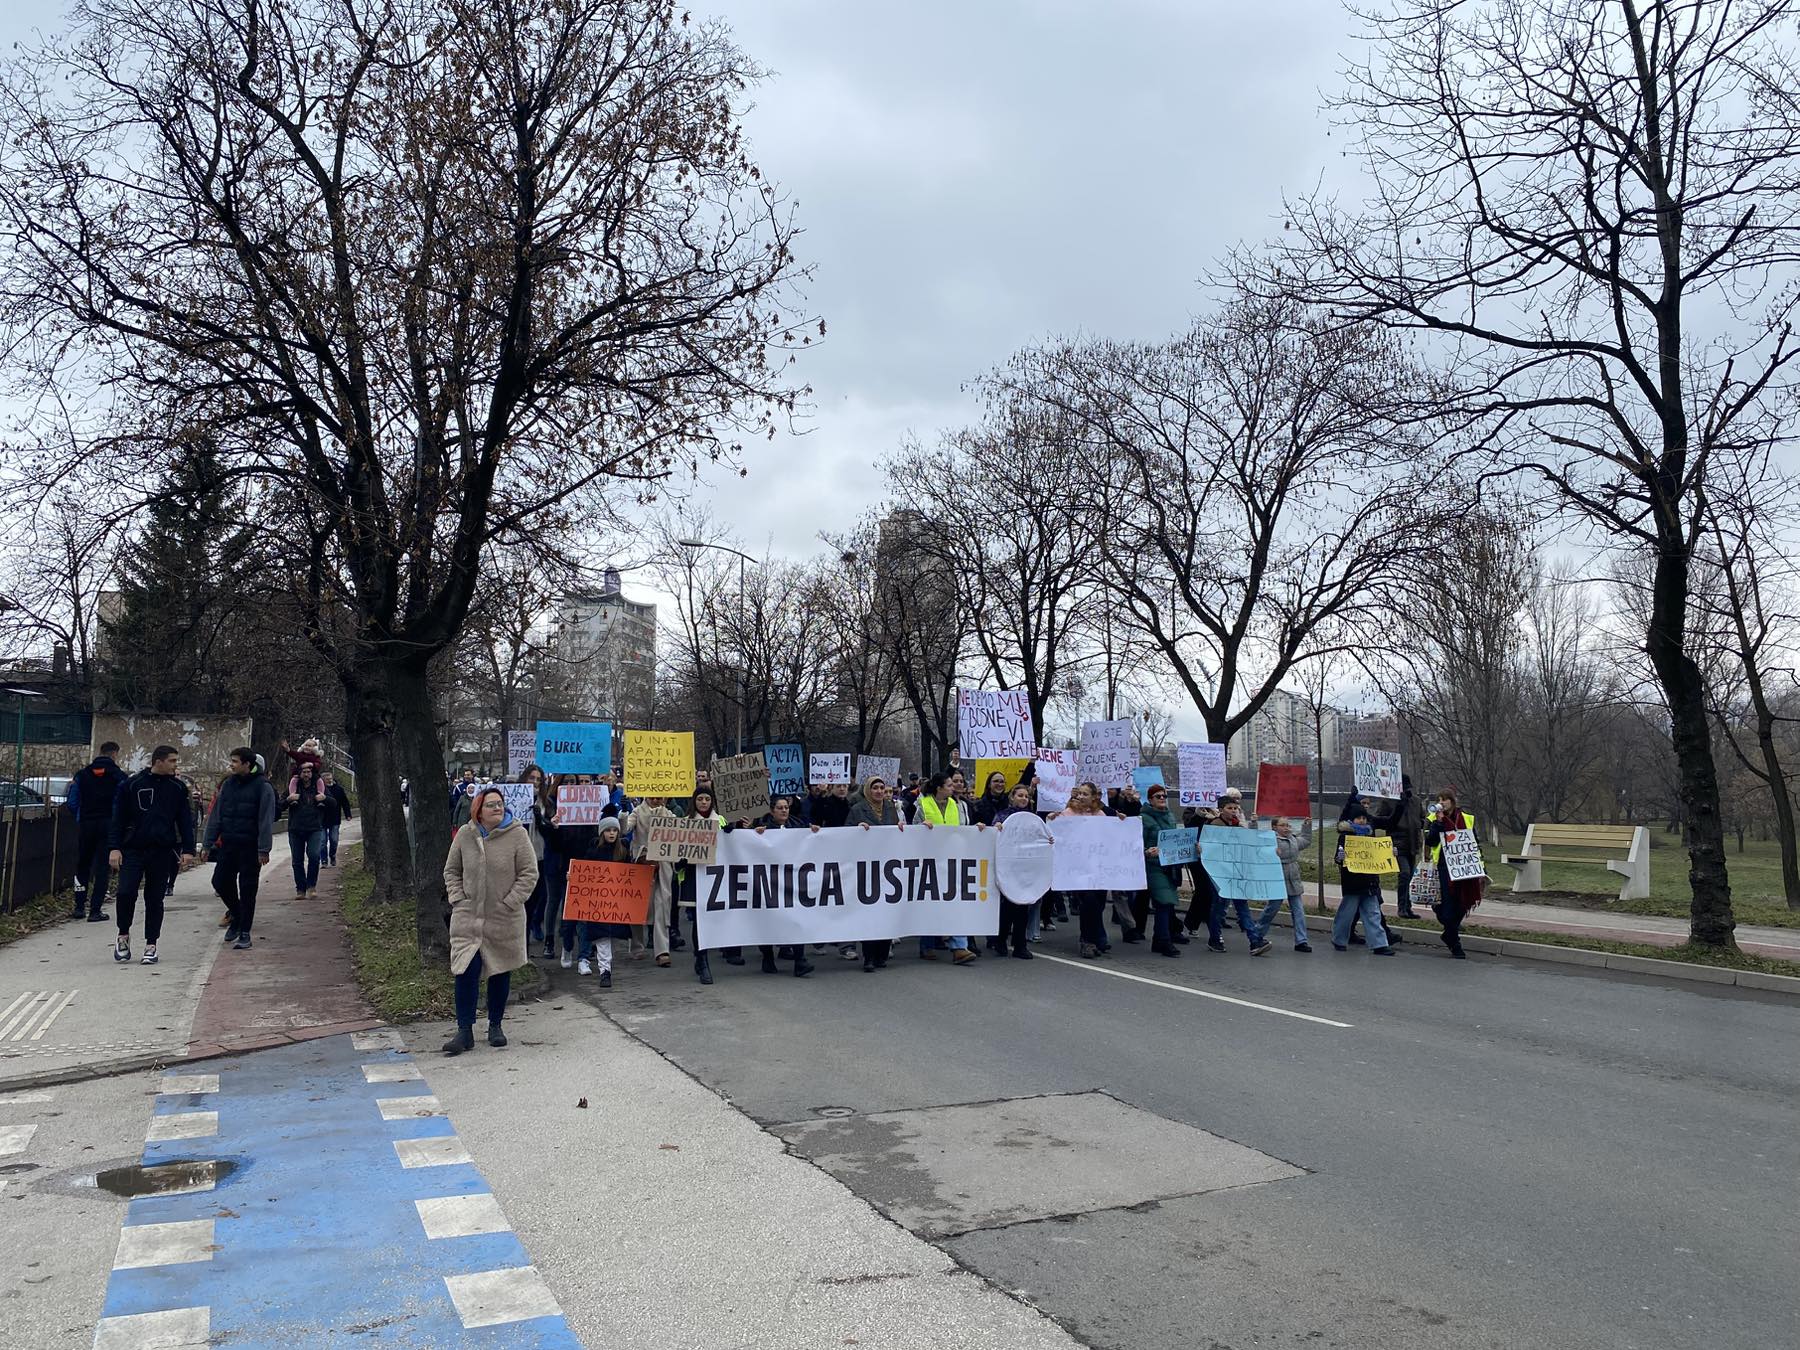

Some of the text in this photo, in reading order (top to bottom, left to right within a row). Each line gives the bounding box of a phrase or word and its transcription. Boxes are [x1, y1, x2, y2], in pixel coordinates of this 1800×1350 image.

[969, 706, 1007, 728] BOSNE
[1006, 719, 1025, 741] VI
[1104, 727, 1122, 738] STE
[634, 735, 677, 745] U INAT
[959, 729, 987, 758] NAS
[543, 739, 584, 754] BUREK
[627, 746, 681, 757] APATIJI
[769, 748, 800, 763] ACTA
[1085, 752, 1117, 765] CIJENE
[627, 758, 681, 769] STRAHU
[1113, 761, 1129, 771] VAS
[627, 770, 692, 780] NEVJERICI
[626, 783, 689, 793] BABAROGAMA
[768, 776, 805, 794] VERBA
[558, 806, 600, 824] PLATE
[651, 818, 713, 831] NISI SITAN
[1457, 831, 1471, 842] ZA
[660, 843, 709, 859] SI BITAN
[572, 865, 636, 877] NAMA JE
[706, 862, 845, 912] ZENICA
[857, 858, 988, 905] USTAJE!
[569, 885, 643, 899] DOMOVINA
[572, 897, 580, 907] A
[577, 910, 632, 922] IMOVINA
